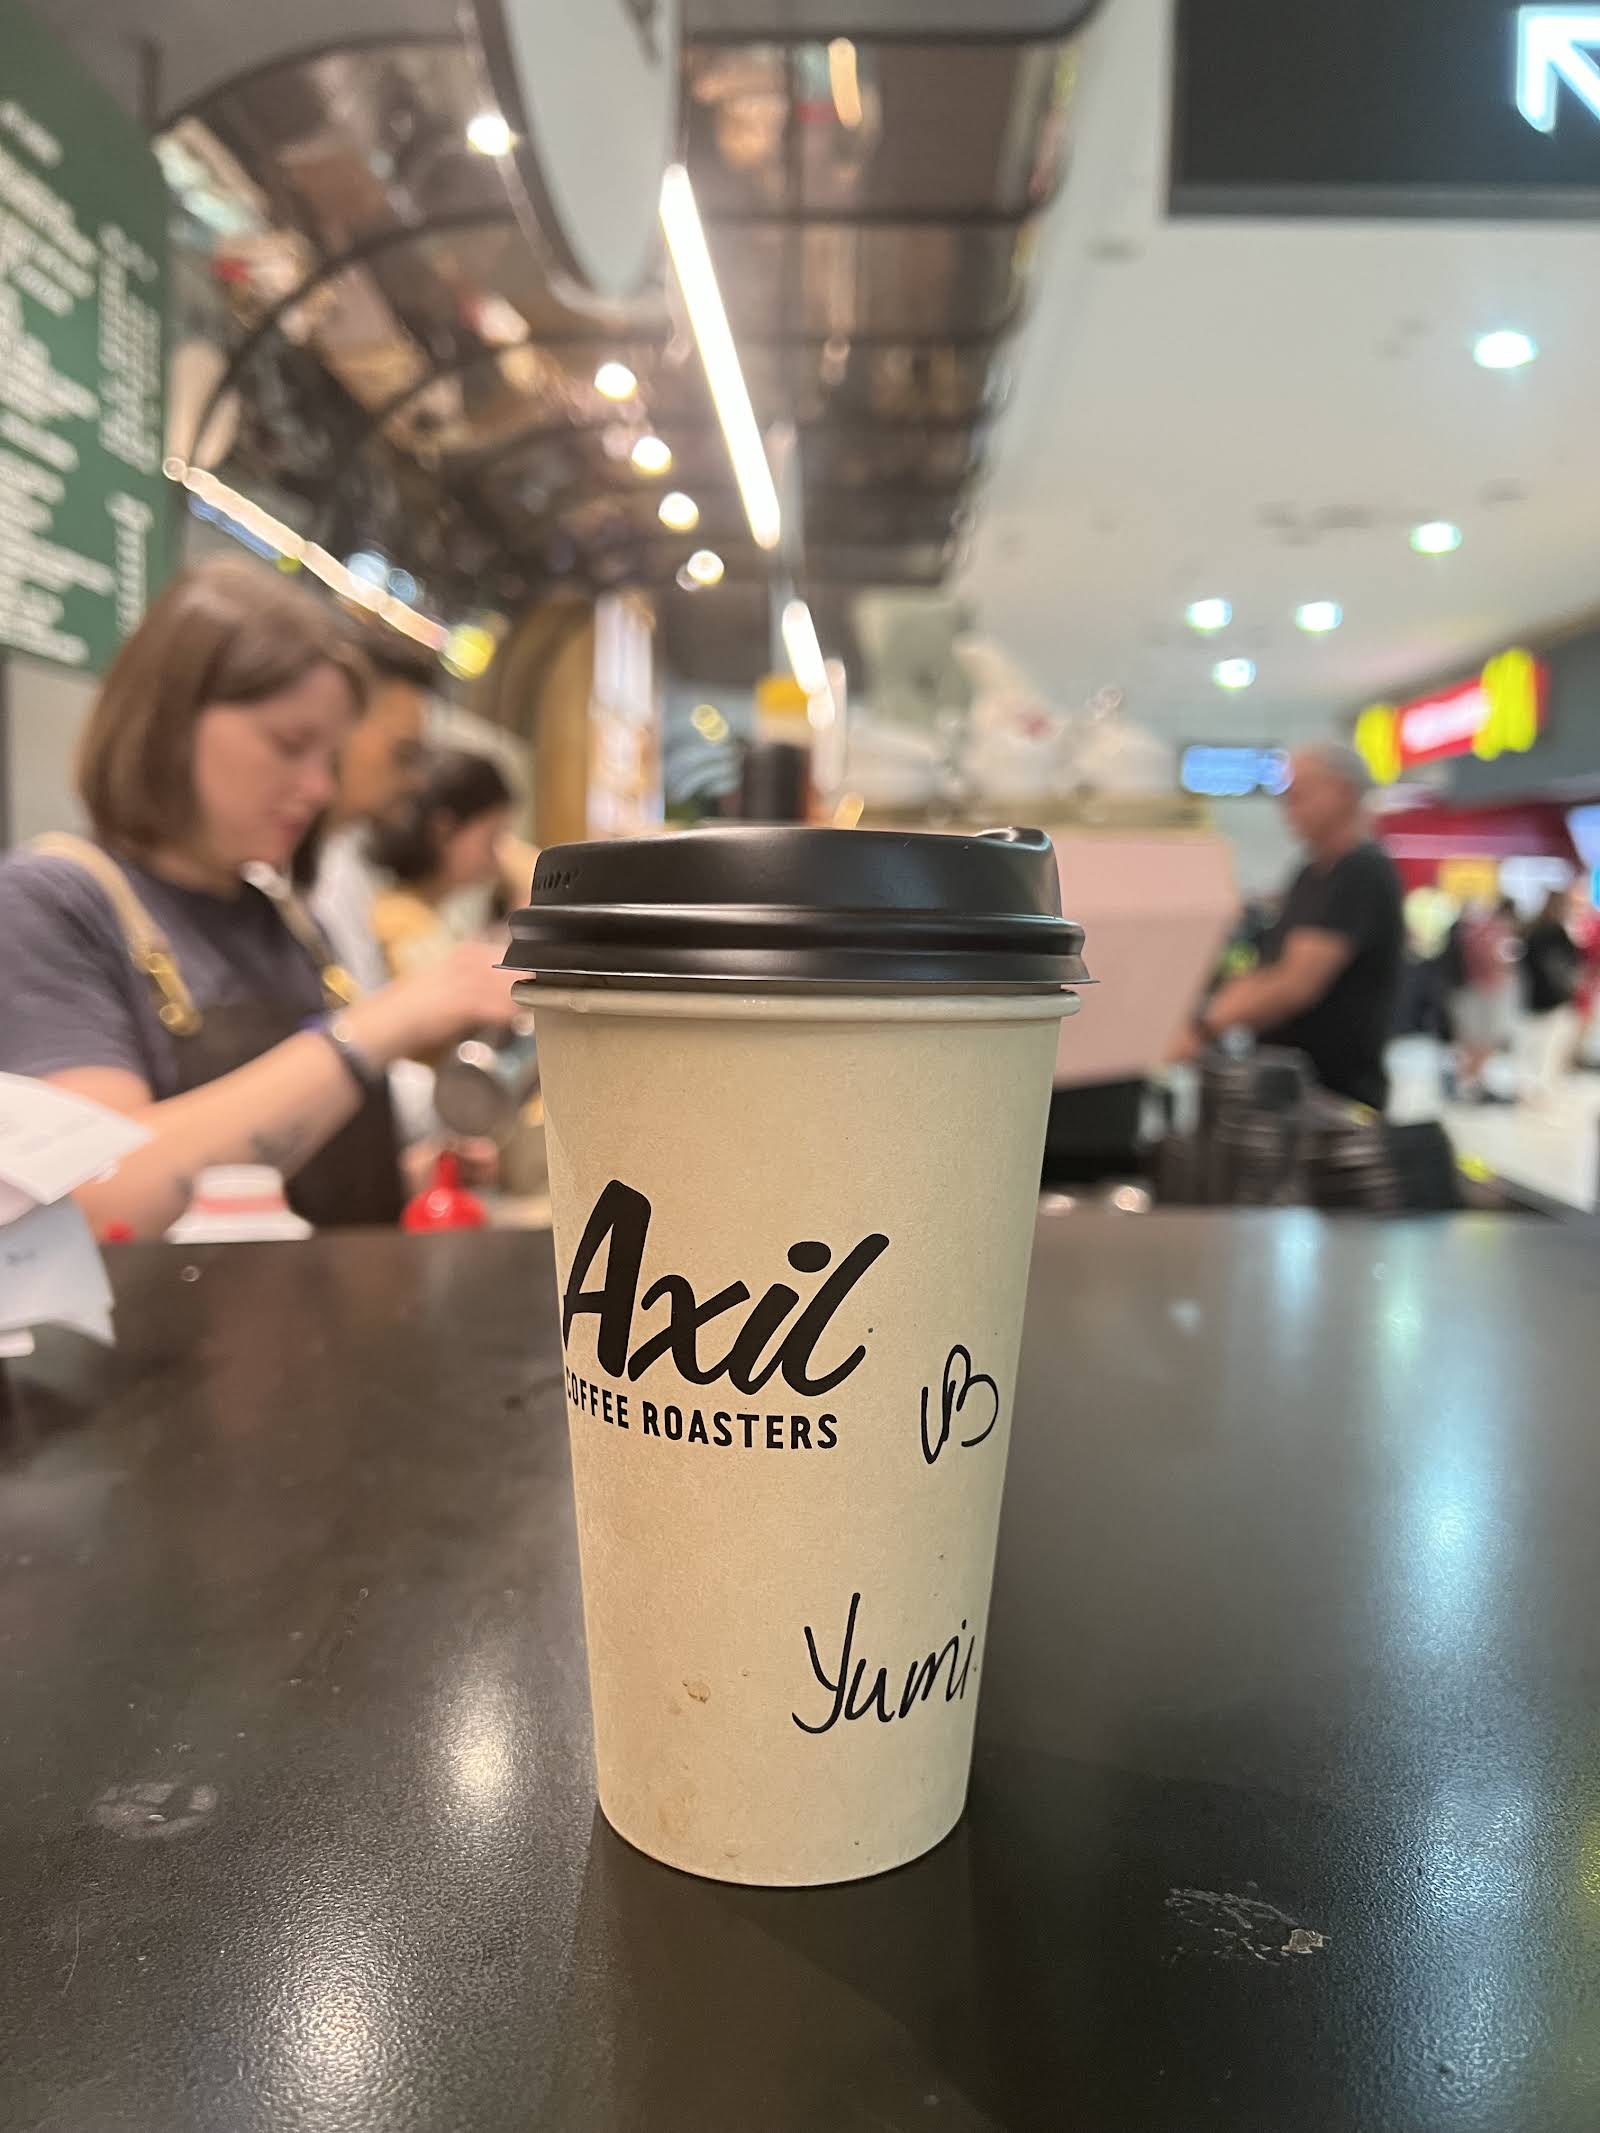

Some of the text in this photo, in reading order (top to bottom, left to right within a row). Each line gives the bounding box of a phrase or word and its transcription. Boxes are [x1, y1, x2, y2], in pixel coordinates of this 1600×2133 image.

[562, 1180, 890, 1397] Axil
[565, 1365, 839, 1450] COFFEE ROASTERS
[791, 1592, 976, 1735] Yumi
